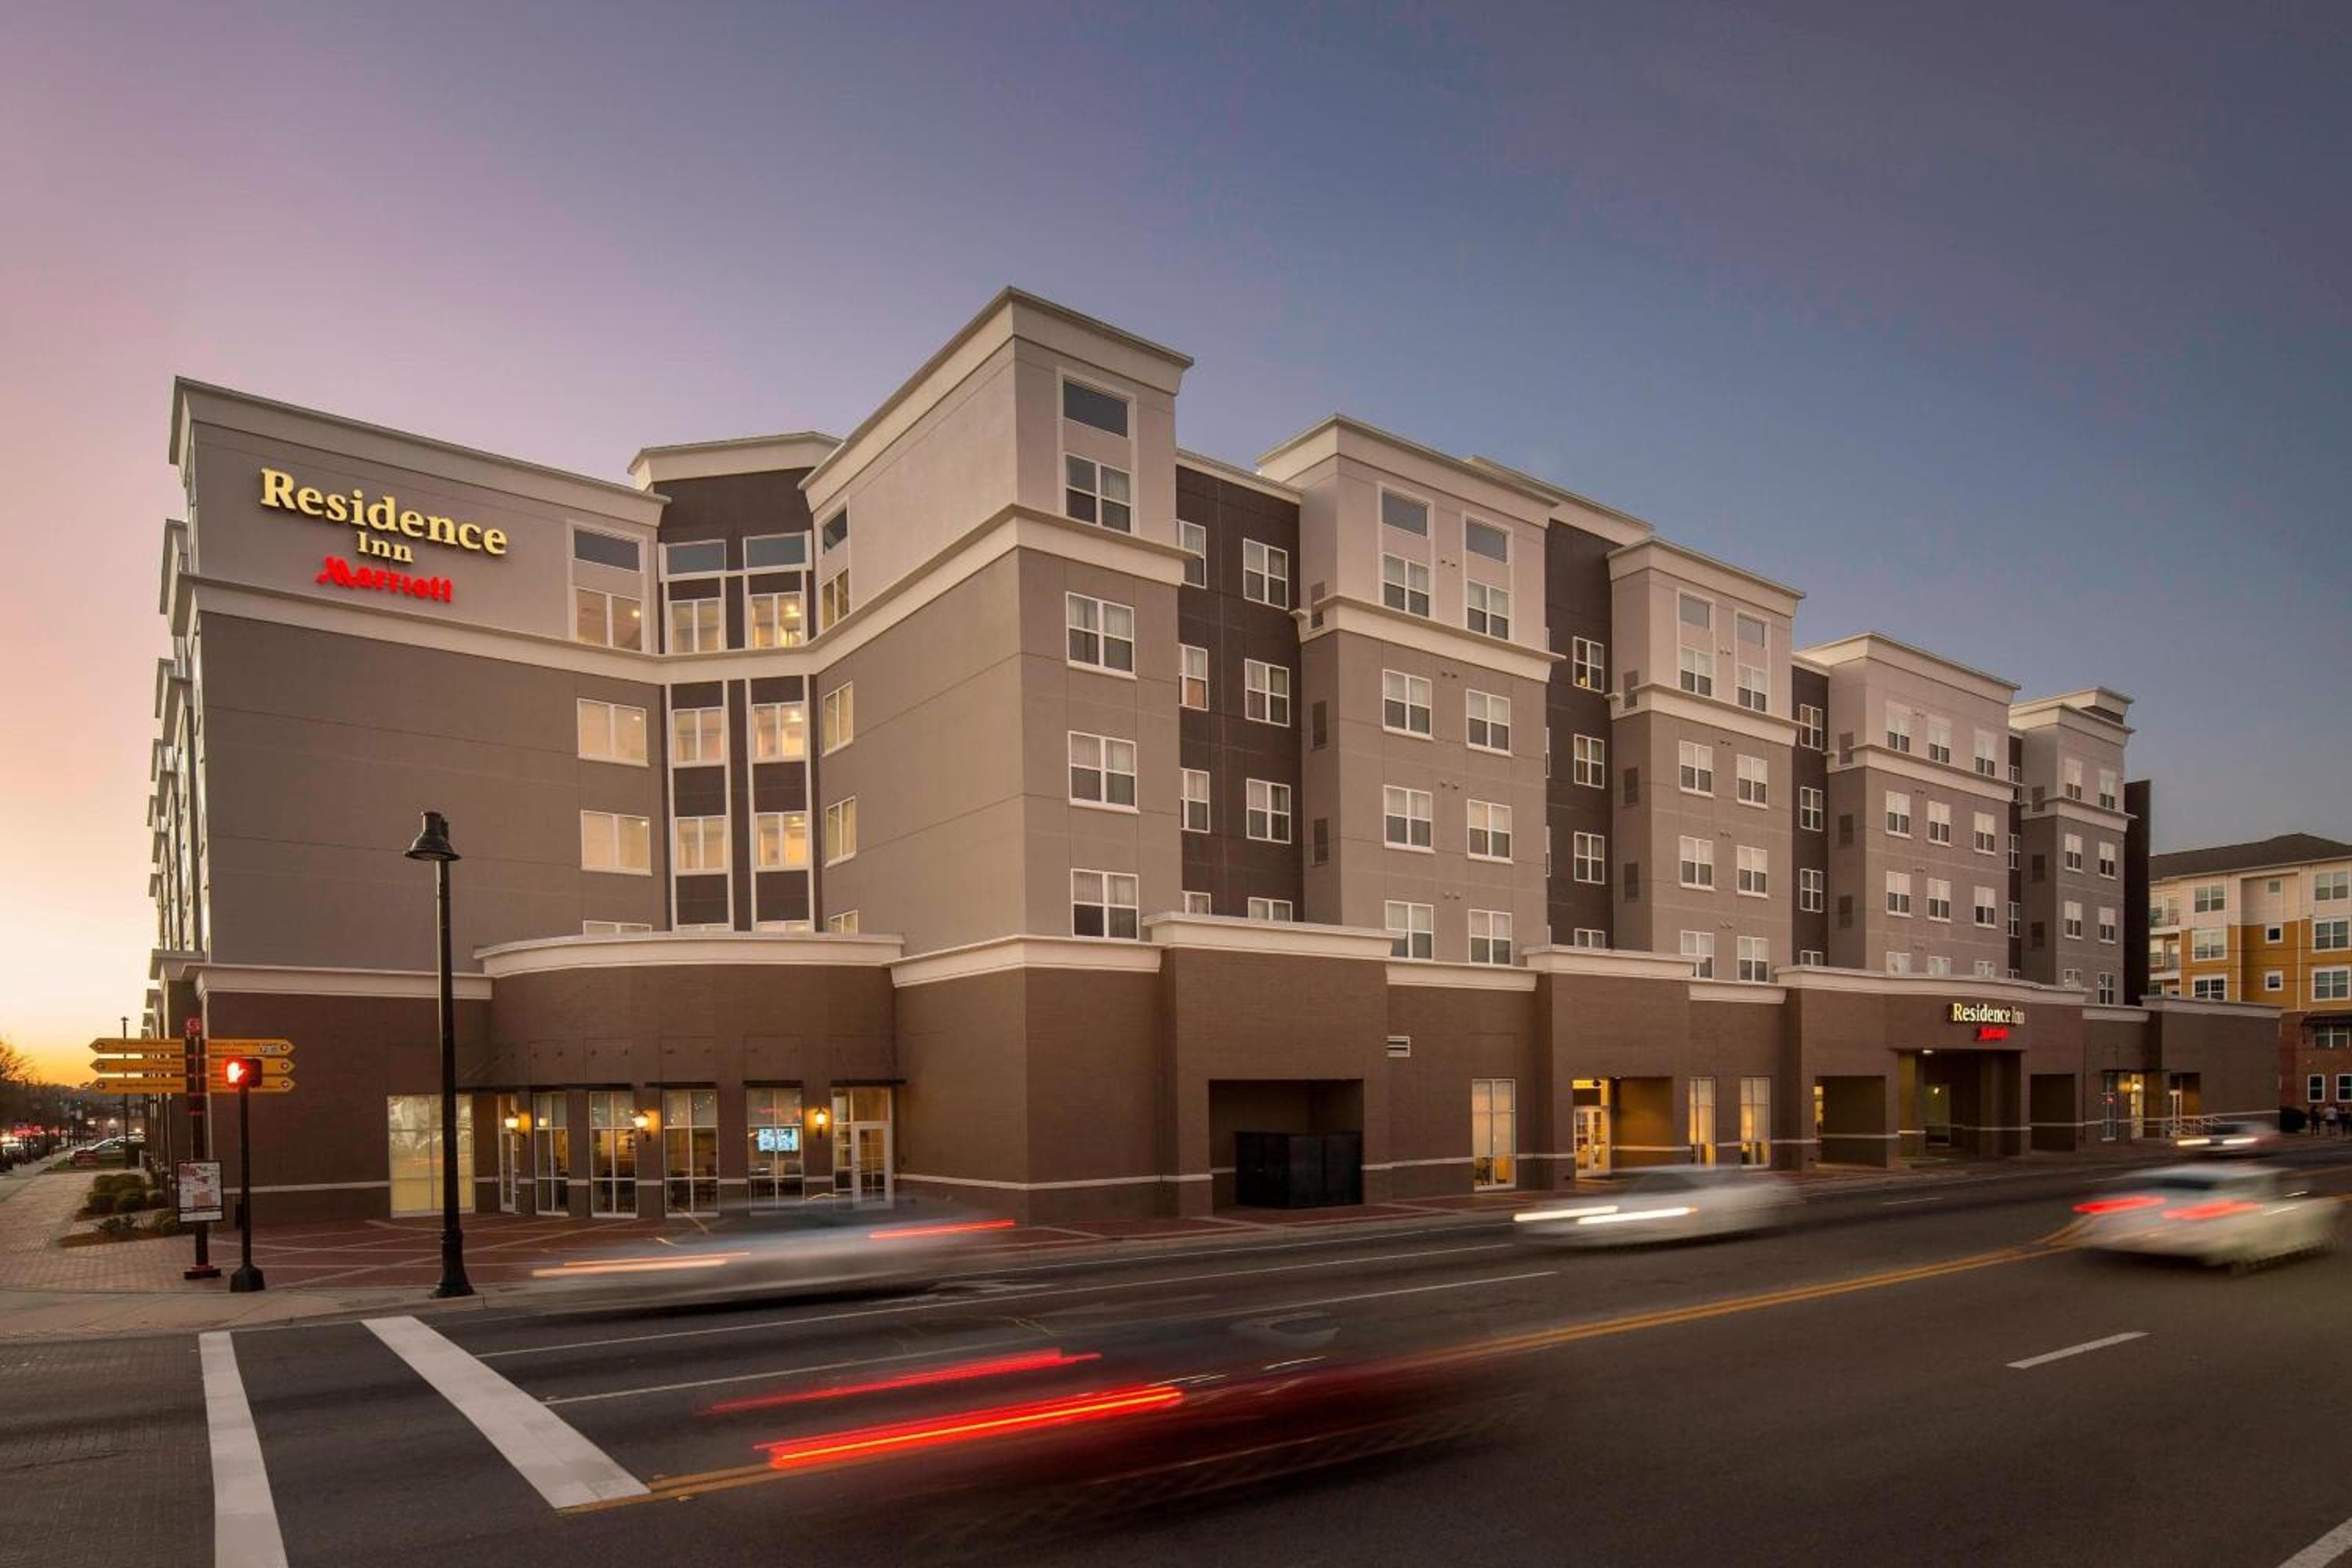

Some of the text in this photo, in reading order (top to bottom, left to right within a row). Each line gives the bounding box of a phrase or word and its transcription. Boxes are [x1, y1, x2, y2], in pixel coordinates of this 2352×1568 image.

[260, 466, 508, 555] Residence
[356, 531, 414, 563] Inn
[315, 555, 453, 603] Marriott
[1952, 1003, 2010, 1023] Residence
